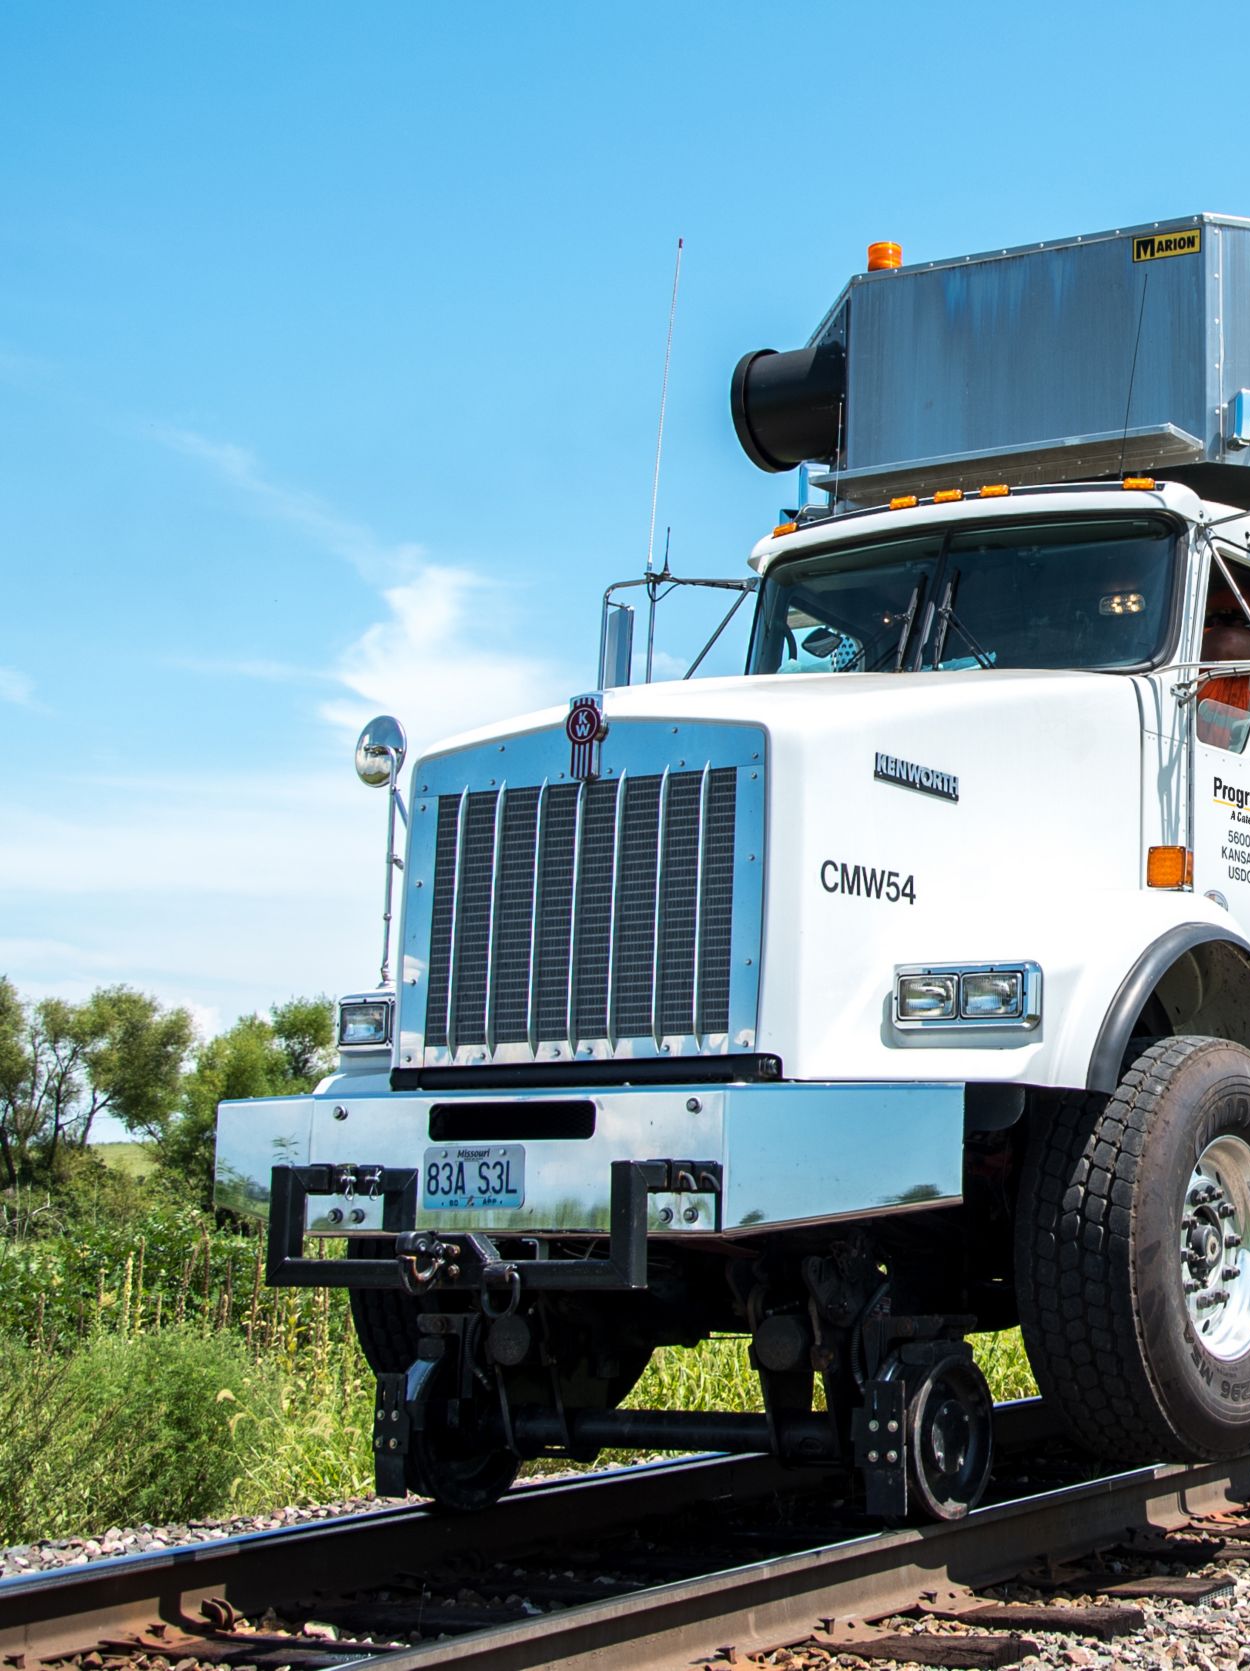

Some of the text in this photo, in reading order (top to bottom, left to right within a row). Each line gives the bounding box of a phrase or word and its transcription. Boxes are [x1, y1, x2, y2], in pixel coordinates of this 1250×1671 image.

[1136, 236, 1195, 259] MARION
[875, 752, 959, 795] KENWORTH
[1230, 810, 1236, 820] A
[1228, 830, 1250, 848] 5600
[820, 859, 917, 905] CMW54
[457, 1148, 490, 1158] Missouri
[427, 1160, 517, 1195] 83A S3L
